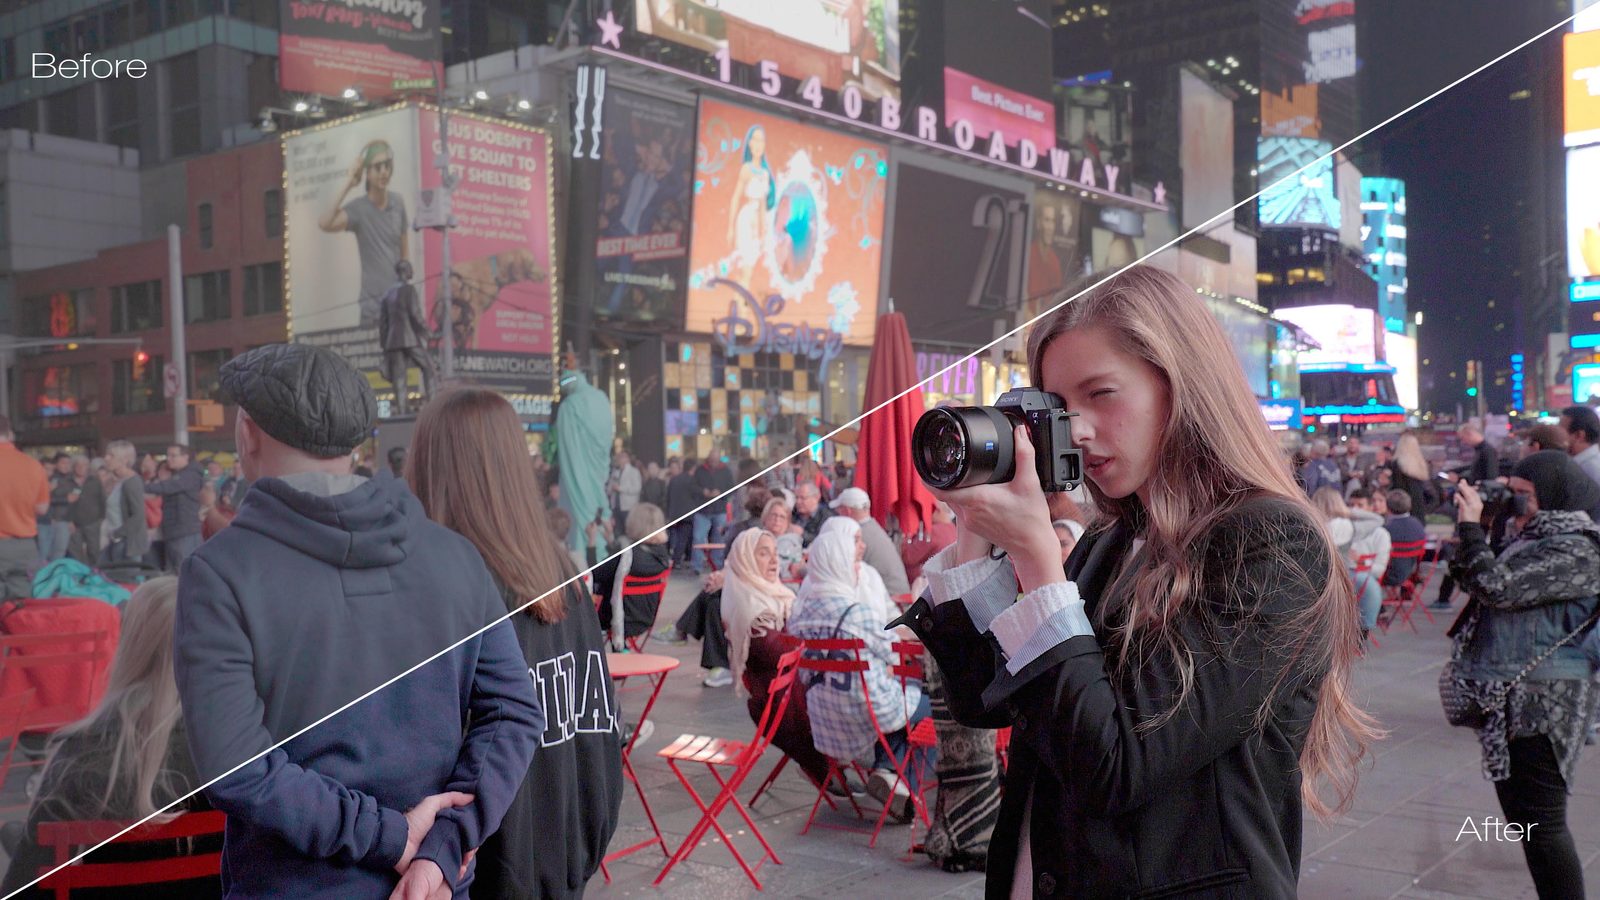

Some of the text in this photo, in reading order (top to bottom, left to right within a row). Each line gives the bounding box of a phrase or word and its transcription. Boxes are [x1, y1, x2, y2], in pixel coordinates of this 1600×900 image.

[474, 126, 532, 151] DOESN'T
[432, 139, 537, 172] GVE SQUAT TO
[468, 167, 532, 192] SHELTERS
[966, 193, 1029, 308] 21
